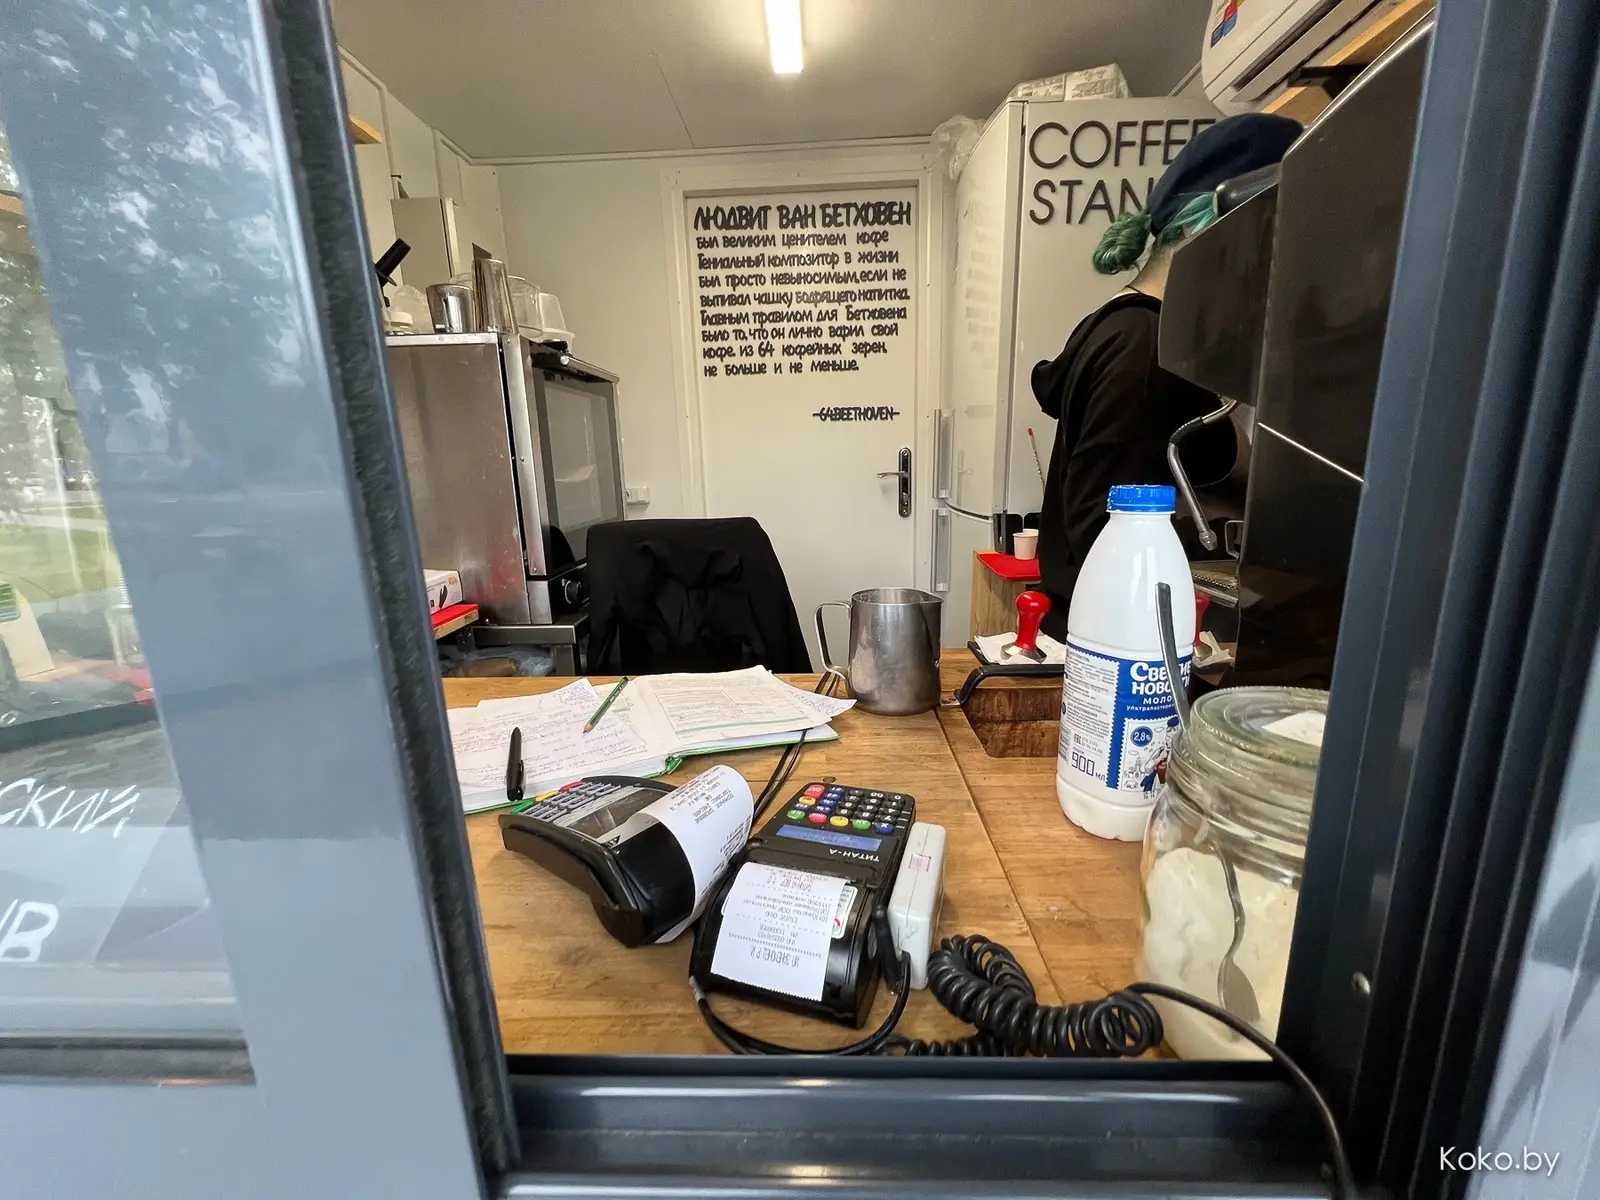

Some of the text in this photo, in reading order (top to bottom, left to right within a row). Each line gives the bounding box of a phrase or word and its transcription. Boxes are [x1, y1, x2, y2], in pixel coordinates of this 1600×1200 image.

[1029, 118, 1217, 170] COFFE
[1029, 177, 1154, 226] STAN
[694, 201, 911, 231] ЛЮДВИГ ВАН БЕТХОВЕН
[722, 234, 776, 248] великим
[782, 232, 847, 249] ценителем
[856, 230, 889, 248] кофе
[697, 253, 765, 270] Гениальный
[767, 251, 839, 270] композитор
[857, 251, 899, 263] жизни
[725, 274, 766, 292] просто
[892, 268, 907, 281] не
[699, 293, 751, 307] выпивал
[753, 291, 793, 308] чашку
[795, 290, 857, 308] бодрящего
[700, 304, 907, 329] Главным правилом для Бетховена
[771, 327, 785, 339] он
[788, 326, 823, 339] лично
[828, 325, 865, 342] варил
[871, 322, 899, 337] свой
[740, 345, 754, 357] из
[758, 340, 775, 357] 64
[782, 342, 842, 360] кофейных
[704, 365, 718, 377] не
[724, 363, 767, 376] больше
[774, 362, 782, 374] и
[789, 362, 803, 374] не
[1071, 751, 1095, 776] 900
[829, 848, 880, 862] ТИТАН-А
